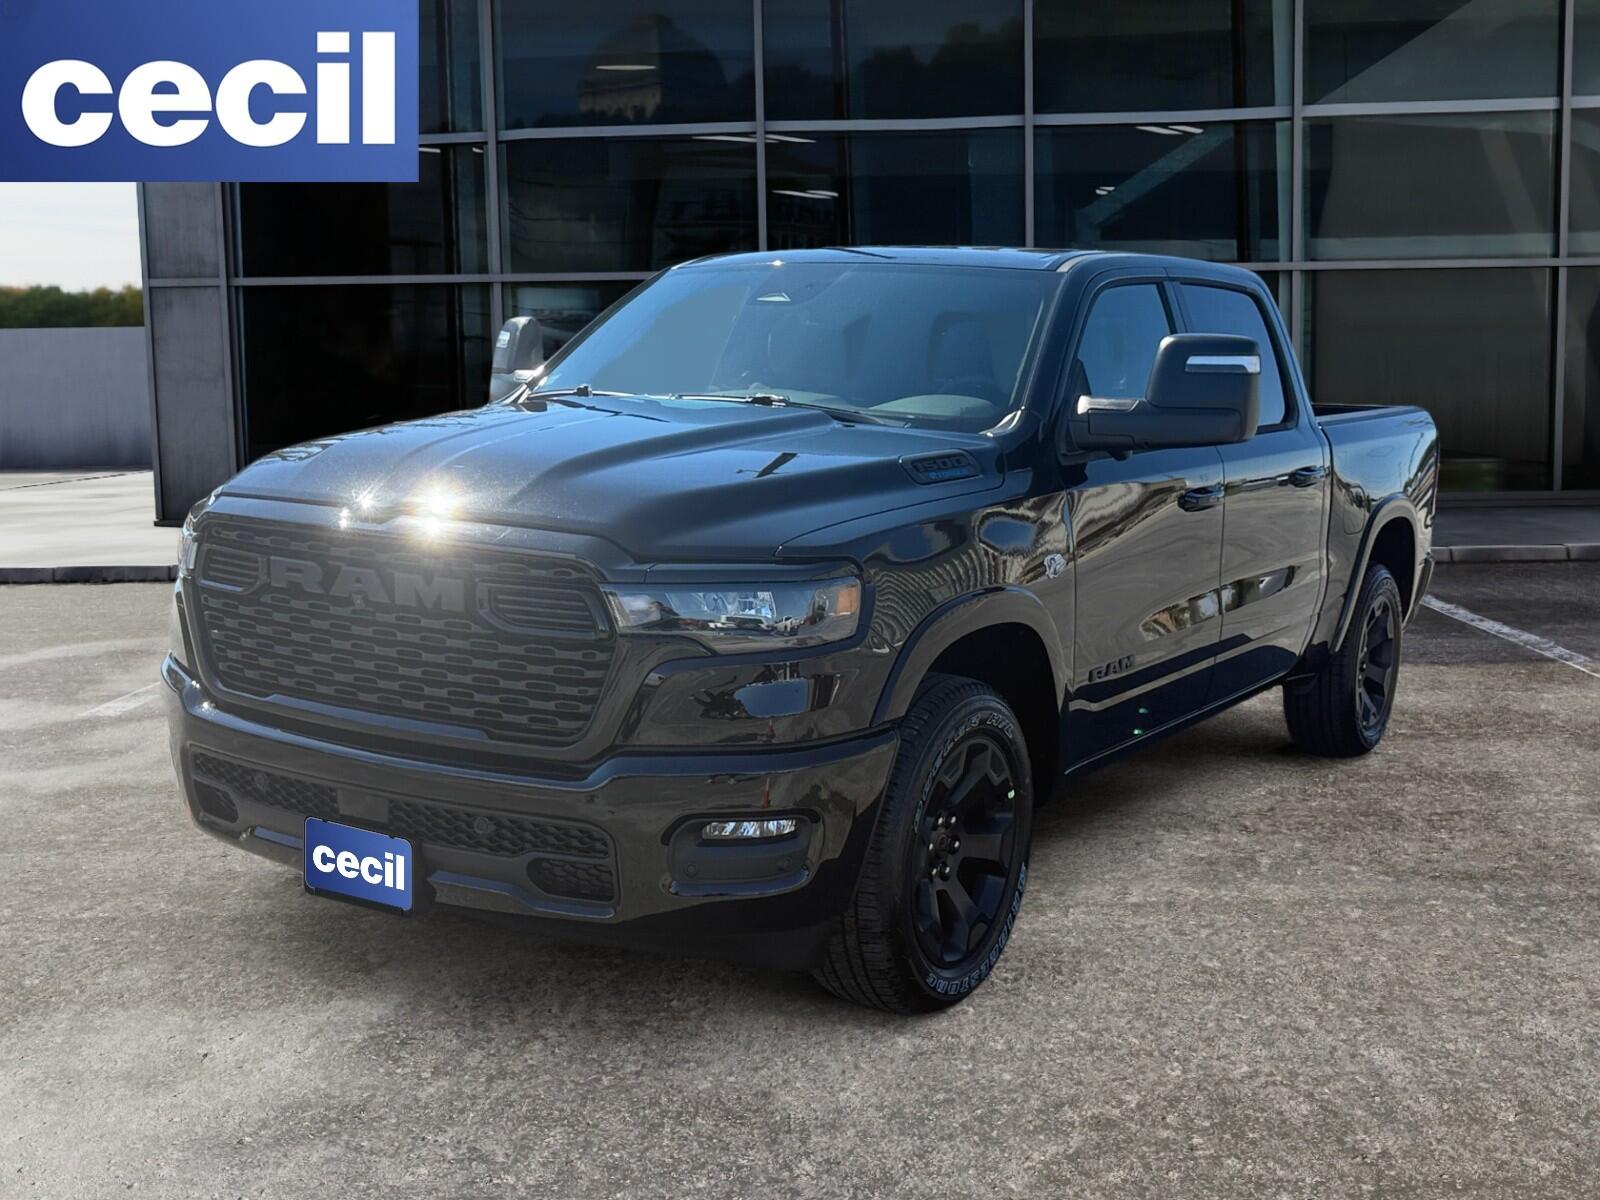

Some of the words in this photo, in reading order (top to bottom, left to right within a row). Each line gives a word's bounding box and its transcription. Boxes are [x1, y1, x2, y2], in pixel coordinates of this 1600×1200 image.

[912, 456, 967, 472] 1500
[270, 556, 465, 612] RAM
[1088, 654, 1134, 682] RAM
[312, 844, 405, 891] cecil
